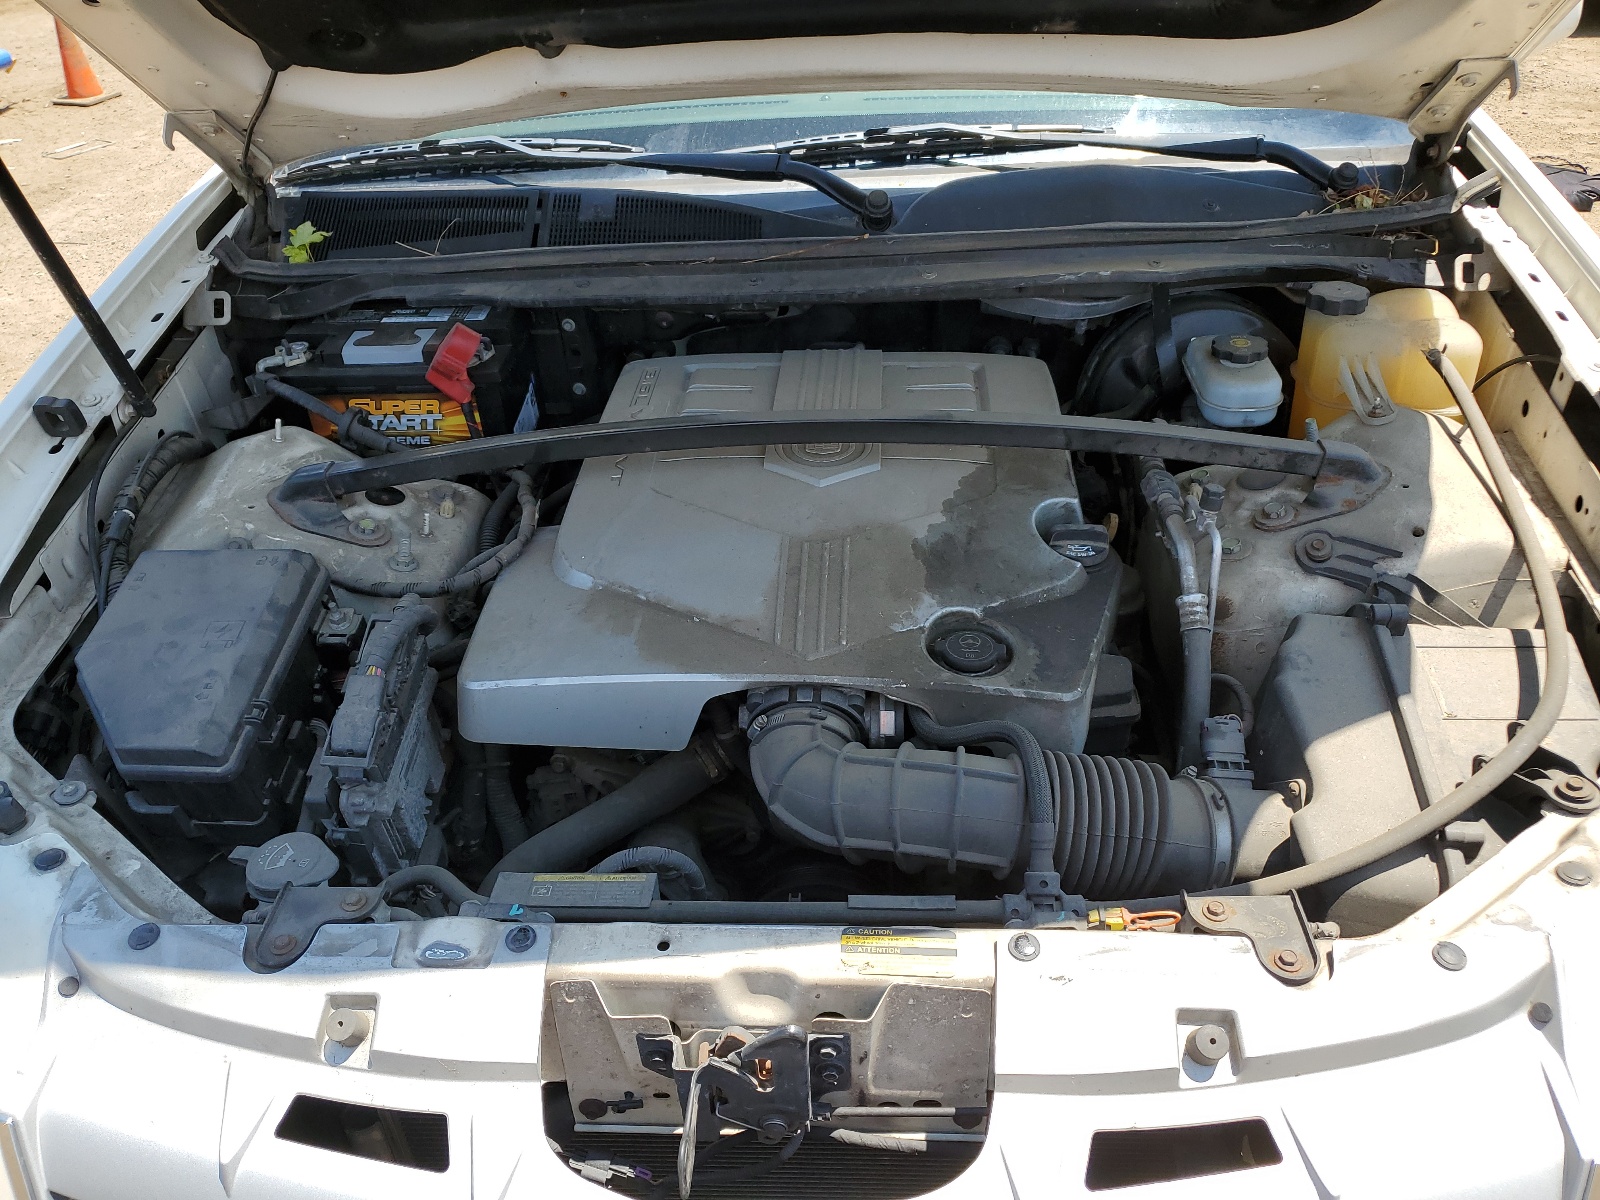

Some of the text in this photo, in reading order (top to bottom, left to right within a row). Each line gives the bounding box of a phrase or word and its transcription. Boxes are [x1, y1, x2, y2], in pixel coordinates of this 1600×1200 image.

[348, 398, 440, 415] SUPER
[368, 414, 443, 431] TART
[857, 946, 901, 954] ATTENTION
